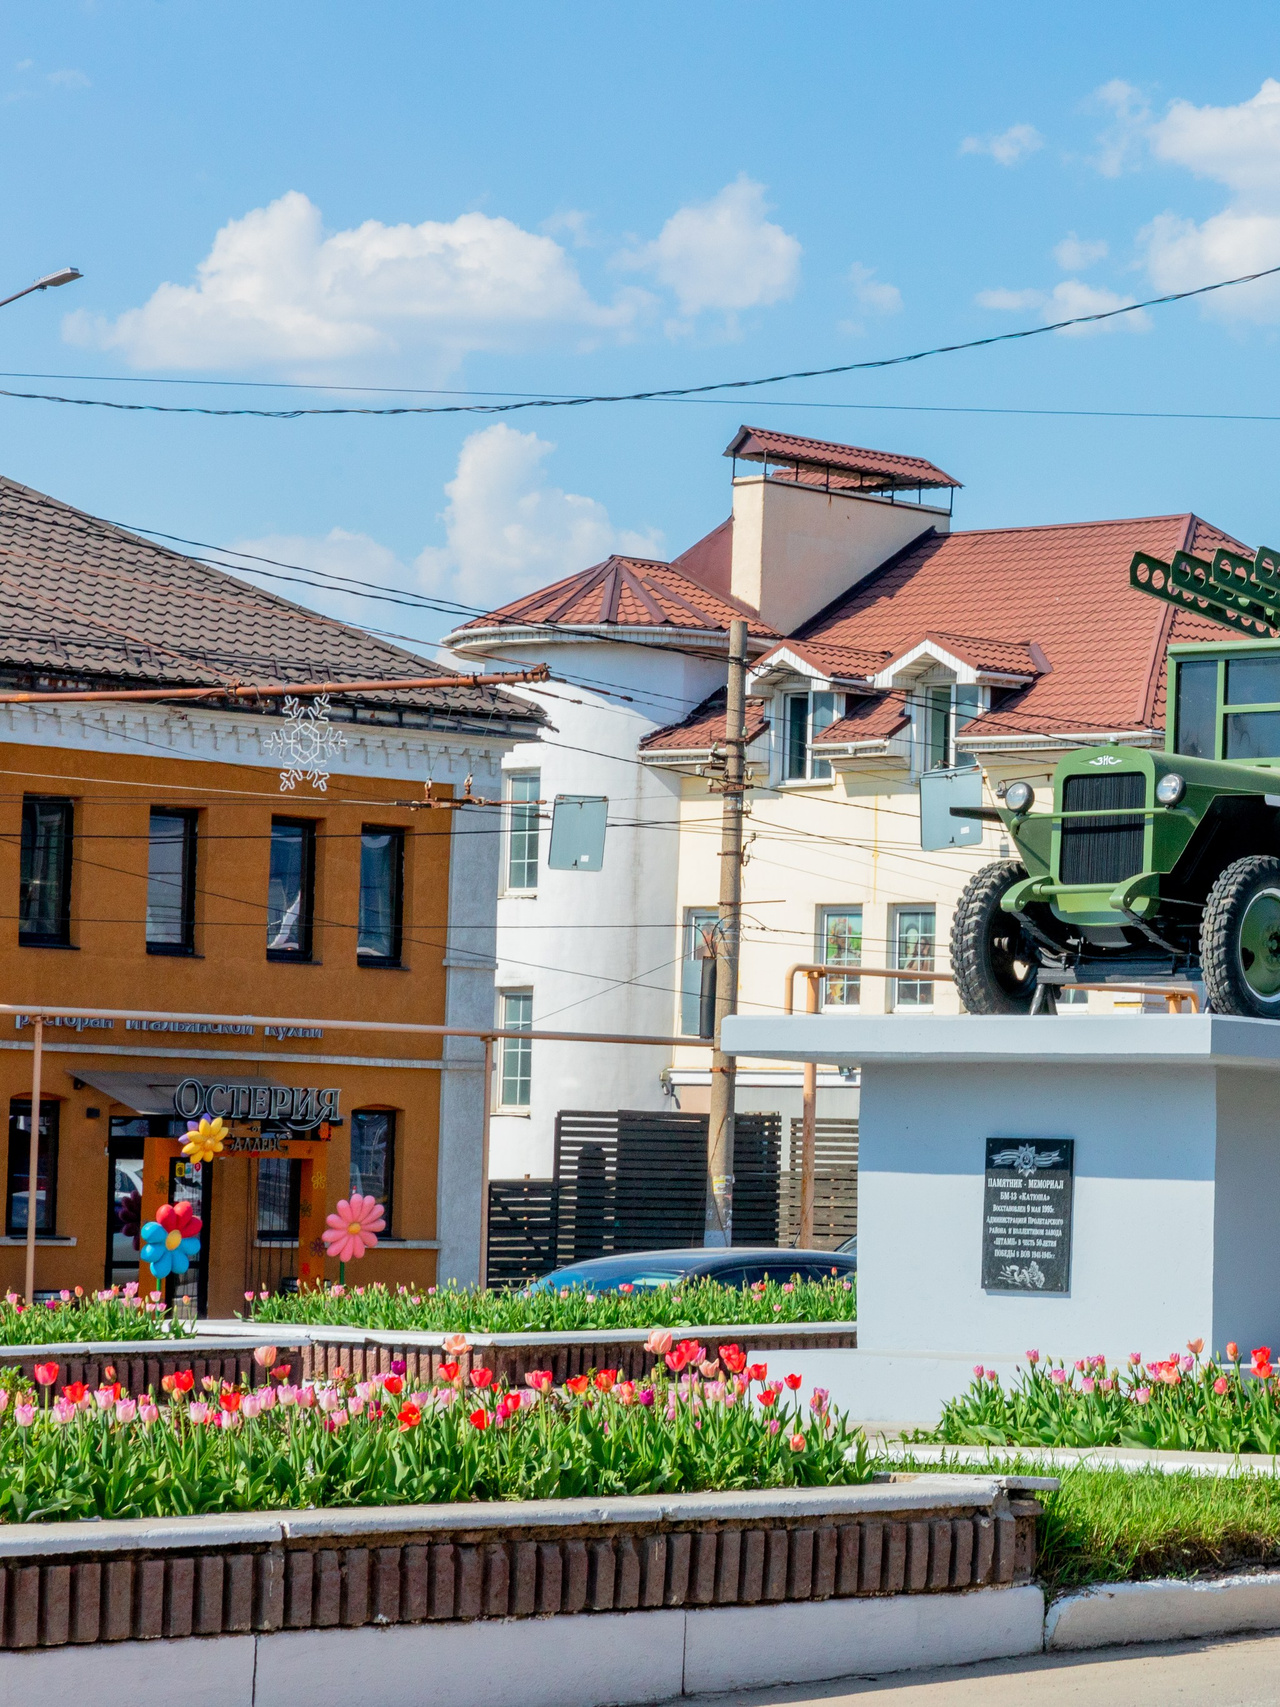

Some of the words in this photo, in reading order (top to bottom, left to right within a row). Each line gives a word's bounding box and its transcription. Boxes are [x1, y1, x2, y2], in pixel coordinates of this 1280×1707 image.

[15, 1014, 115, 1032] рсторан
[987, 1178, 1023, 1188] ПАМЯТНИК
[1028, 1179, 1064, 1189] МЕМОРИАЛ
[1000, 1192, 1017, 1200] БМ-13
